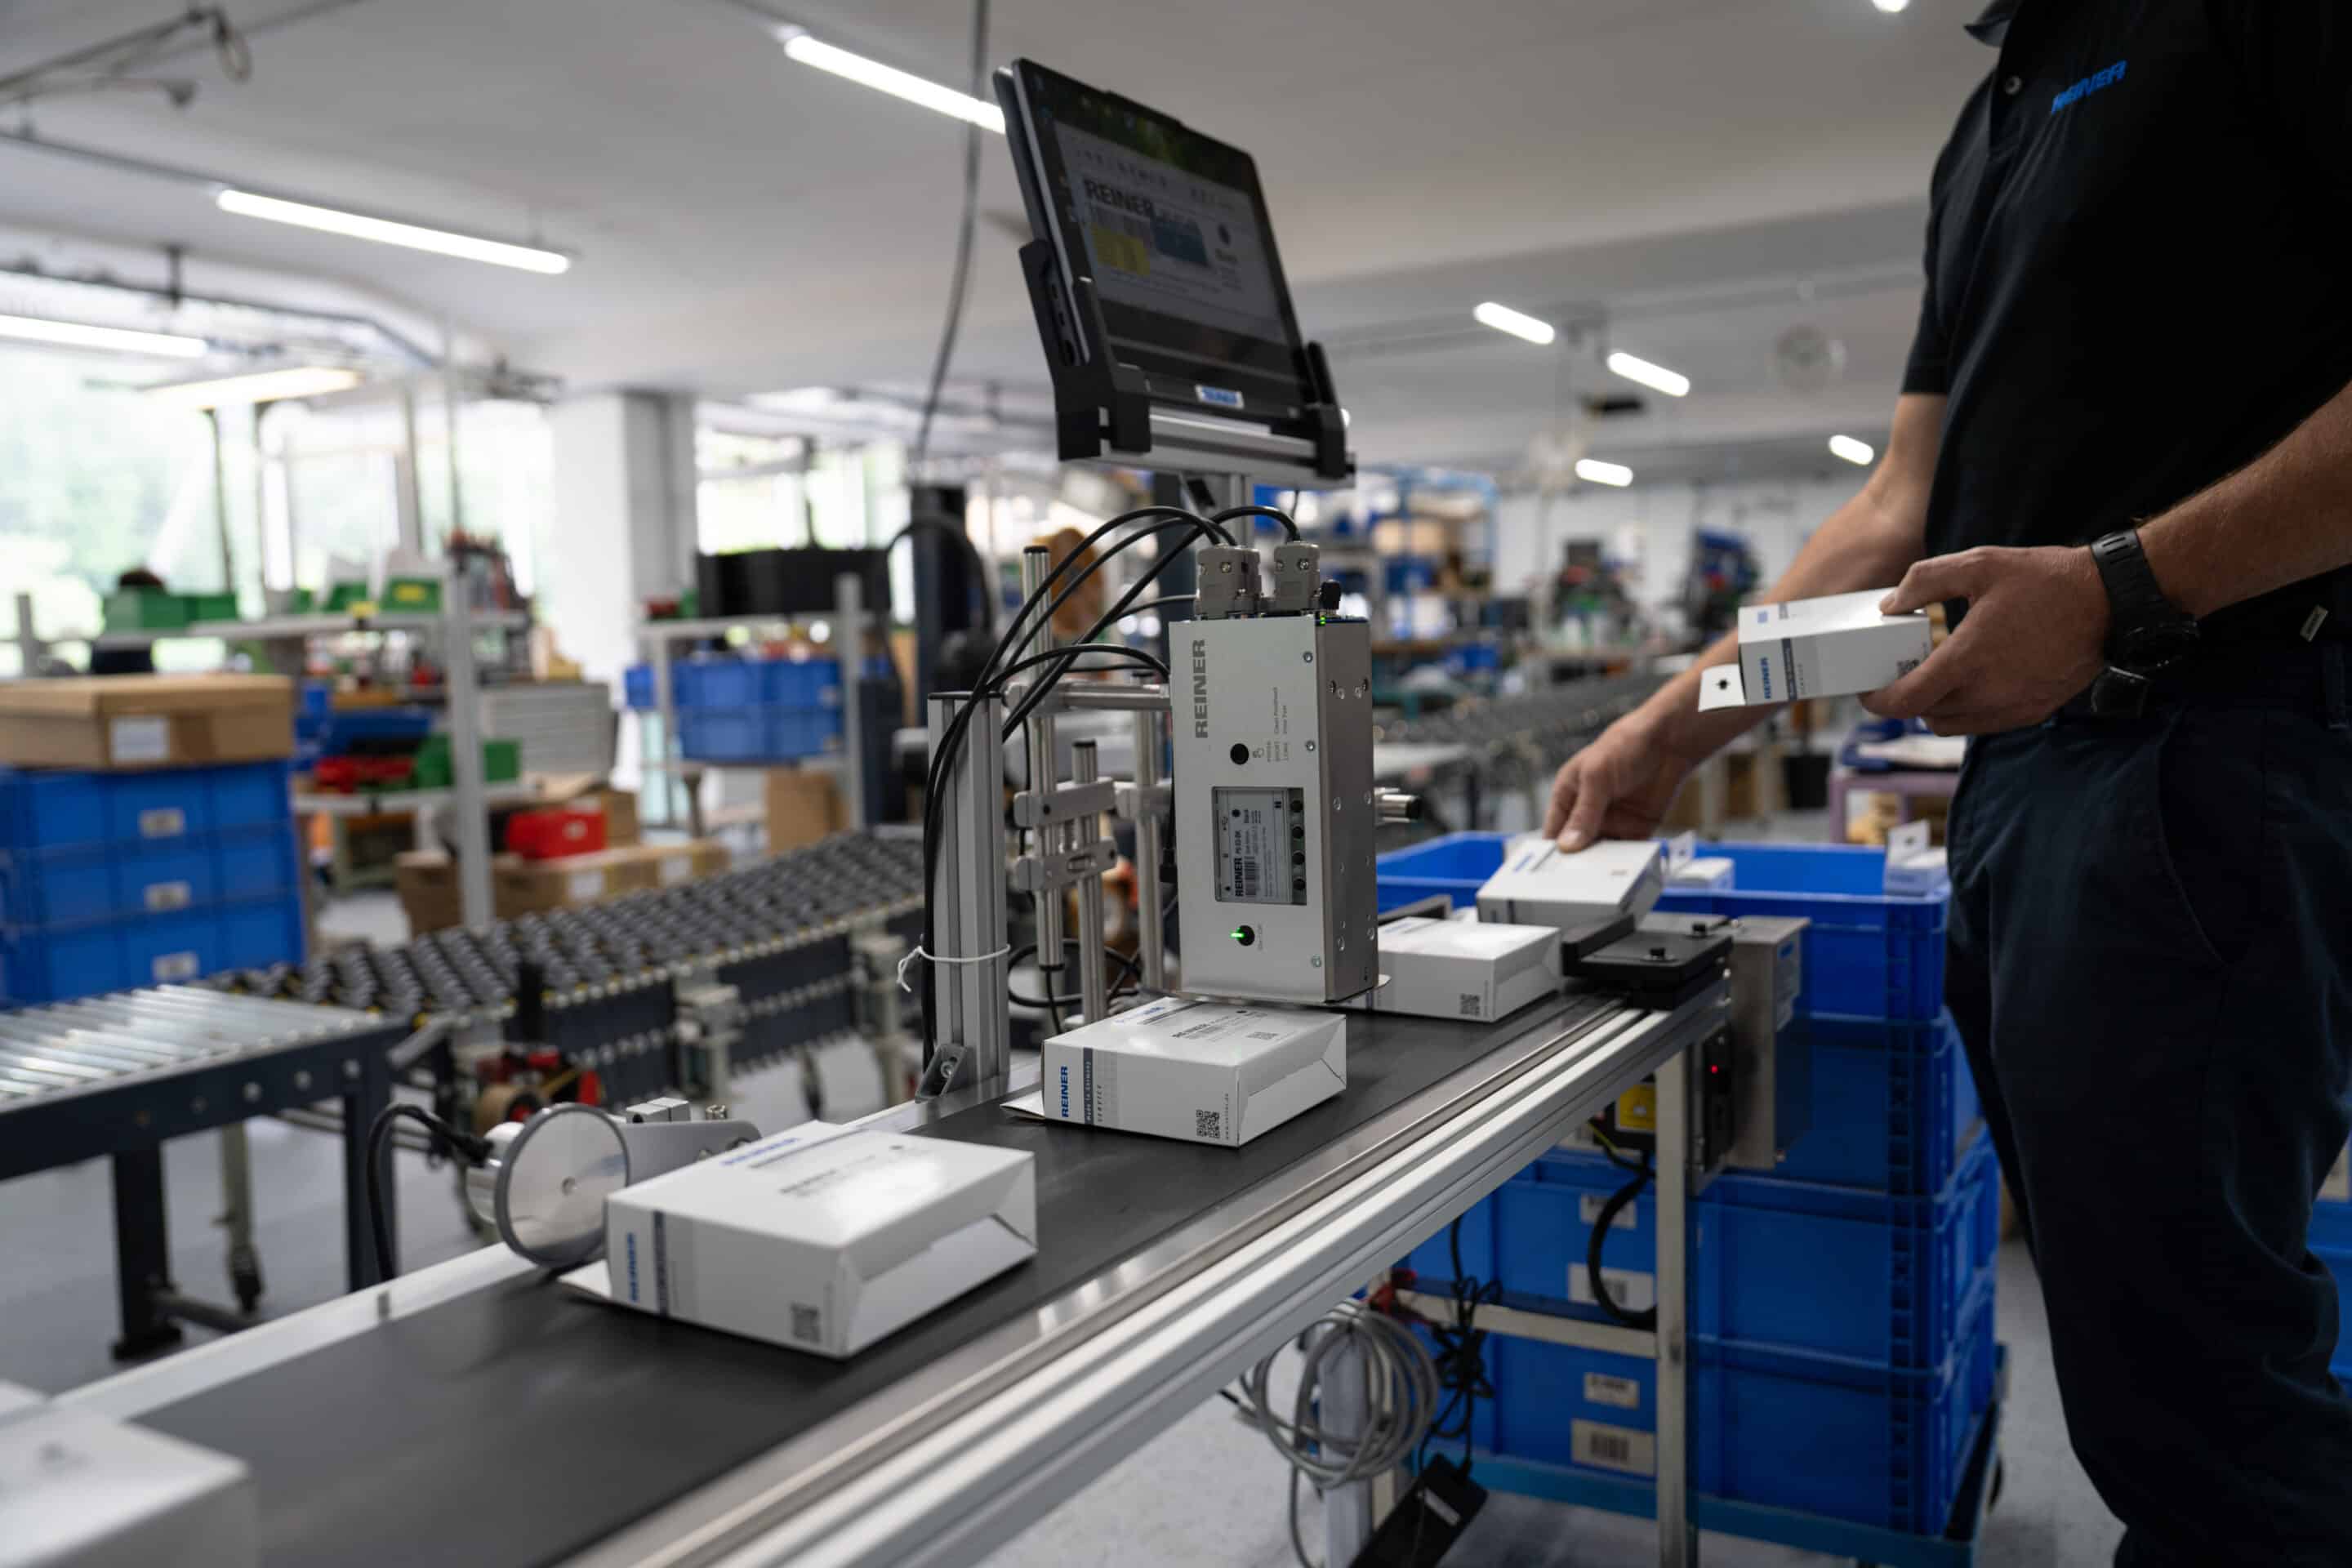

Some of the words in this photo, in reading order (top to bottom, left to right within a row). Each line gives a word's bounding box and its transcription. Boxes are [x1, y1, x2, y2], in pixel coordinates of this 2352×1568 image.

[1084, 178, 1156, 220] REINER
[1192, 639, 1209, 738] REINER
[1233, 858, 1244, 897] REINER
[1061, 1066, 1069, 1118] REINER
